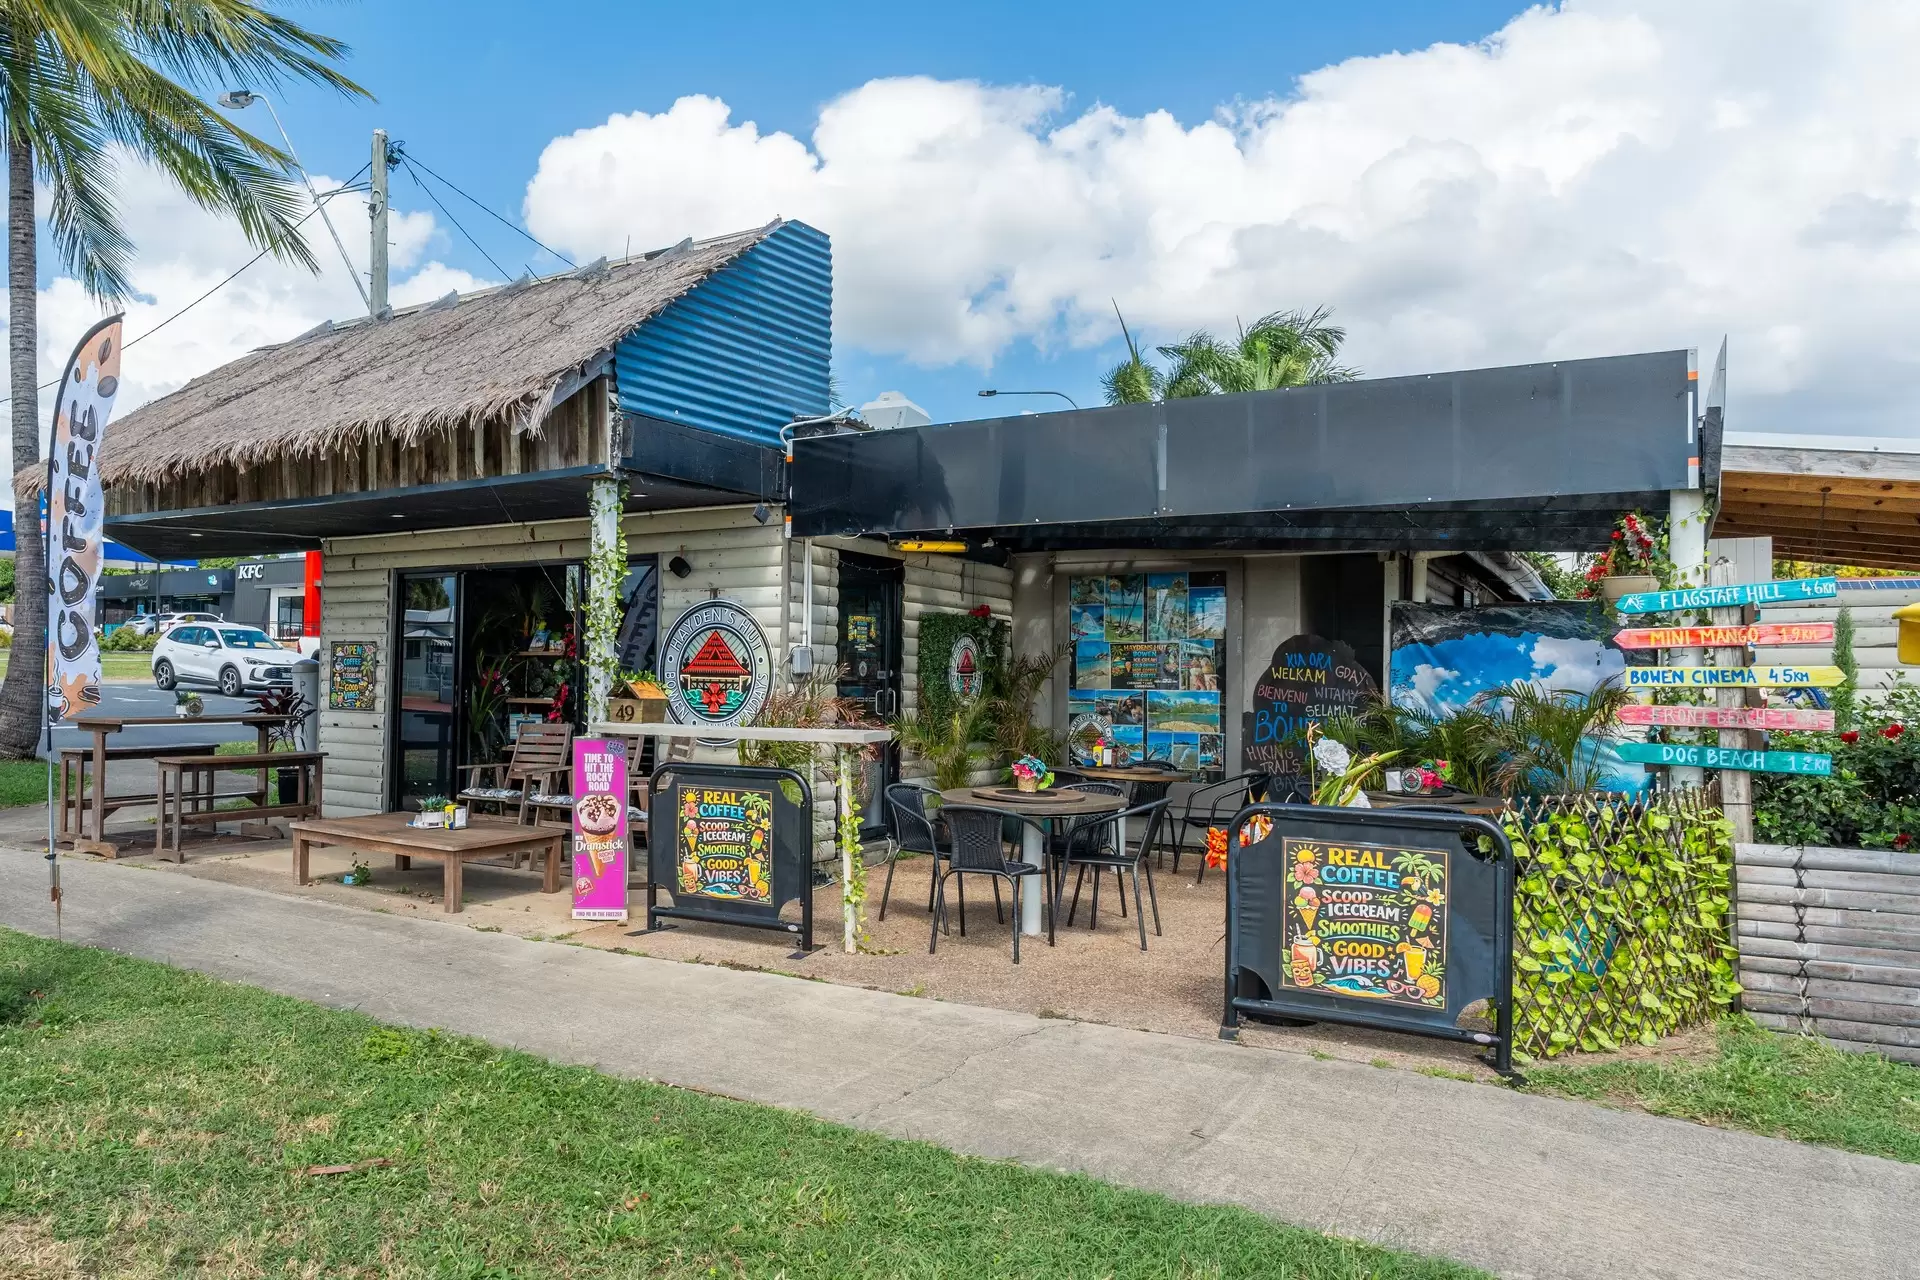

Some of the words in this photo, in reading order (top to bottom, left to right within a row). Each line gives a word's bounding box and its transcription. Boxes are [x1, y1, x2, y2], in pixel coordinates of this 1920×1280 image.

[56, 399, 99, 663] COFFEE
[238, 564, 264, 579] KFC
[1660, 587, 1740, 608] FLAGSTAFF
[1746, 584, 1785, 601] HILL
[670, 608, 737, 652] HAYDEN'S
[738, 618, 765, 651] HUT
[1649, 631, 1690, 646] MINI
[1700, 628, 1759, 644] MANGO
[343, 644, 363, 655] OPEN
[343, 657, 361, 665] COFFEE
[1286, 652, 1307, 668] KIA
[1309, 652, 1332, 671] ORA
[1272, 667, 1326, 684] WELKAM
[1630, 669, 1684, 684] BOWEN
[1692, 669, 1757, 684] CINEMA
[343, 691, 360, 700] VIBES
[665, 672, 690, 721] BOWEN
[1257, 684, 1308, 704] BIENVENU
[615, 704, 635, 722] 49
[1272, 702, 1288, 713] TO
[1305, 704, 1358, 718] SELAMAT
[1651, 708, 1708, 724] FRONT
[1717, 709, 1765, 725] BEACH
[584, 753, 602, 763] TIME
[603, 753, 614, 763] TO
[1246, 745, 1294, 761] HIKING
[1662, 747, 1698, 764] DOG
[1707, 749, 1765, 769] BEACH
[584, 763, 597, 772] HIT
[599, 763, 614, 773] THE
[1260, 759, 1300, 776] TRAILS
[586, 772, 613, 782] ROCKY
[588, 781, 610, 791] ROAD
[703, 791, 741, 805] REAL
[699, 804, 745, 819] COFFEE
[699, 821, 730, 832] SCOOP
[703, 831, 746, 843] ICECREAM
[575, 839, 624, 852] Drumstick
[697, 843, 746, 857] SMOOTHIES
[707, 858, 738, 870] GOOD
[1328, 847, 1392, 870] REAL
[705, 869, 741, 884] VIBES
[1321, 865, 1400, 889] COFFEE
[1321, 889, 1373, 904] SCOOP
[1328, 903, 1400, 922] ICECREAM
[1317, 919, 1401, 942] SMOOTHIES
[1333, 941, 1386, 958] GOOD
[1329, 956, 1391, 978] VIBES
